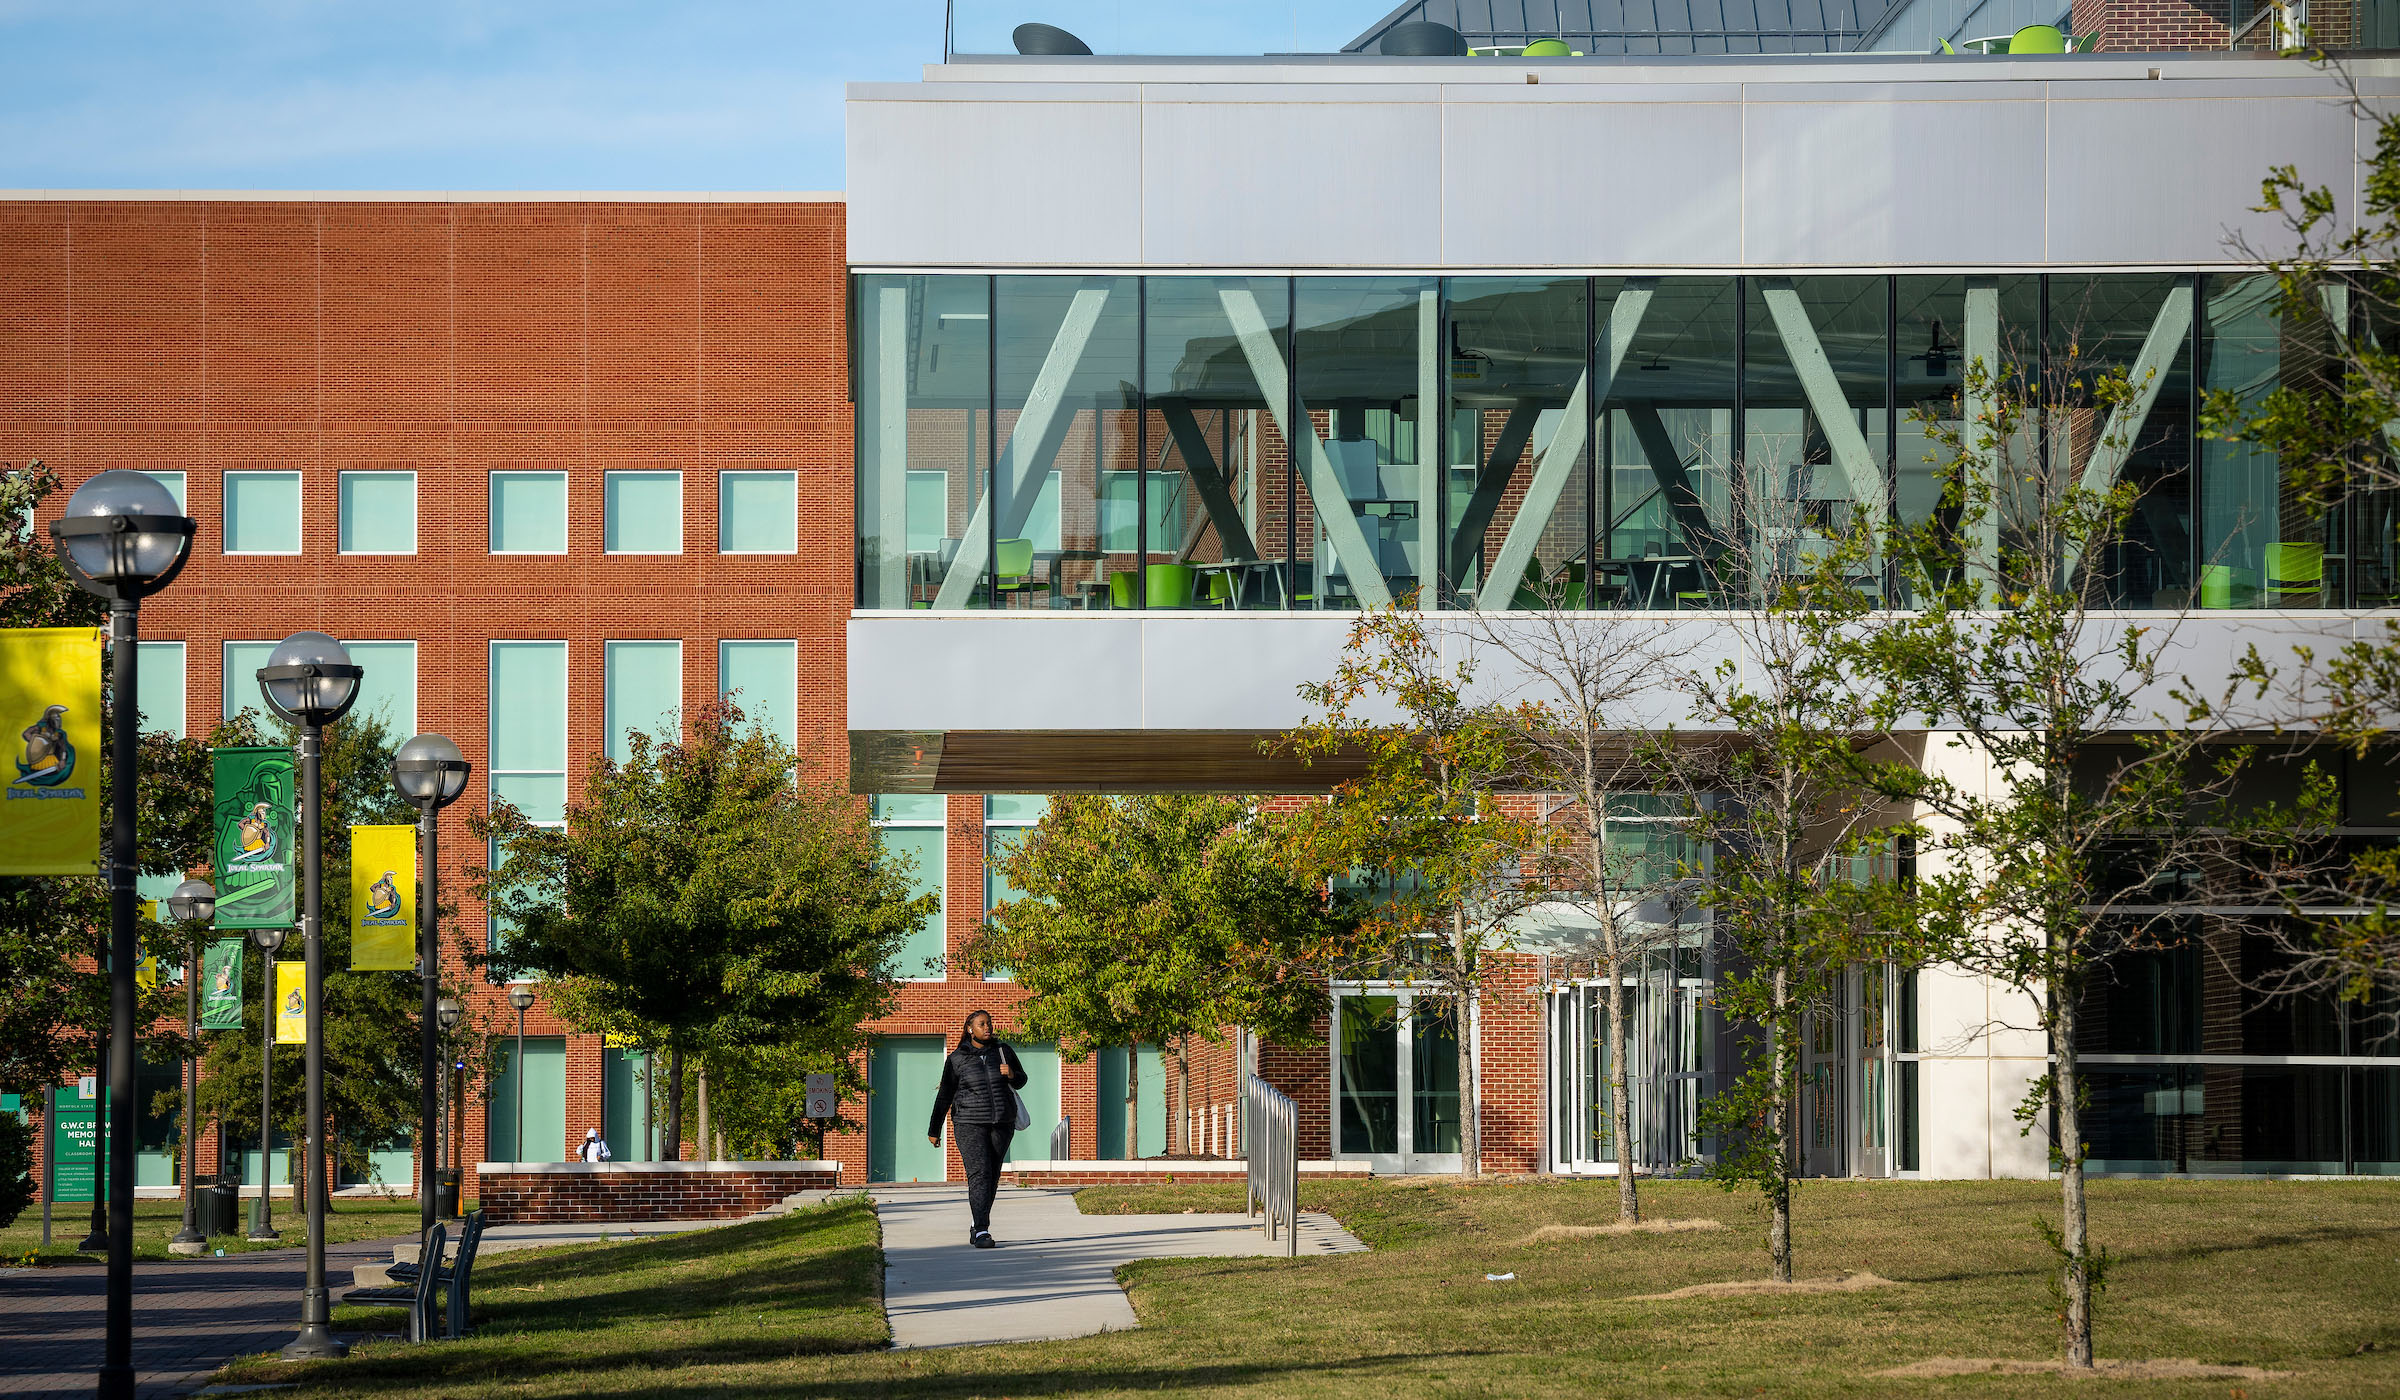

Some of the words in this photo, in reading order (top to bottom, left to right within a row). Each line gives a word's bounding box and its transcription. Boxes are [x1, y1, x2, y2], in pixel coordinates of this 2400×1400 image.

[36, 787, 86, 800] SPARTAN
[227, 863, 249, 873] IDEAL
[250, 863, 285, 873] SPARTAN
[60, 1121, 85, 1129] G.W.C
